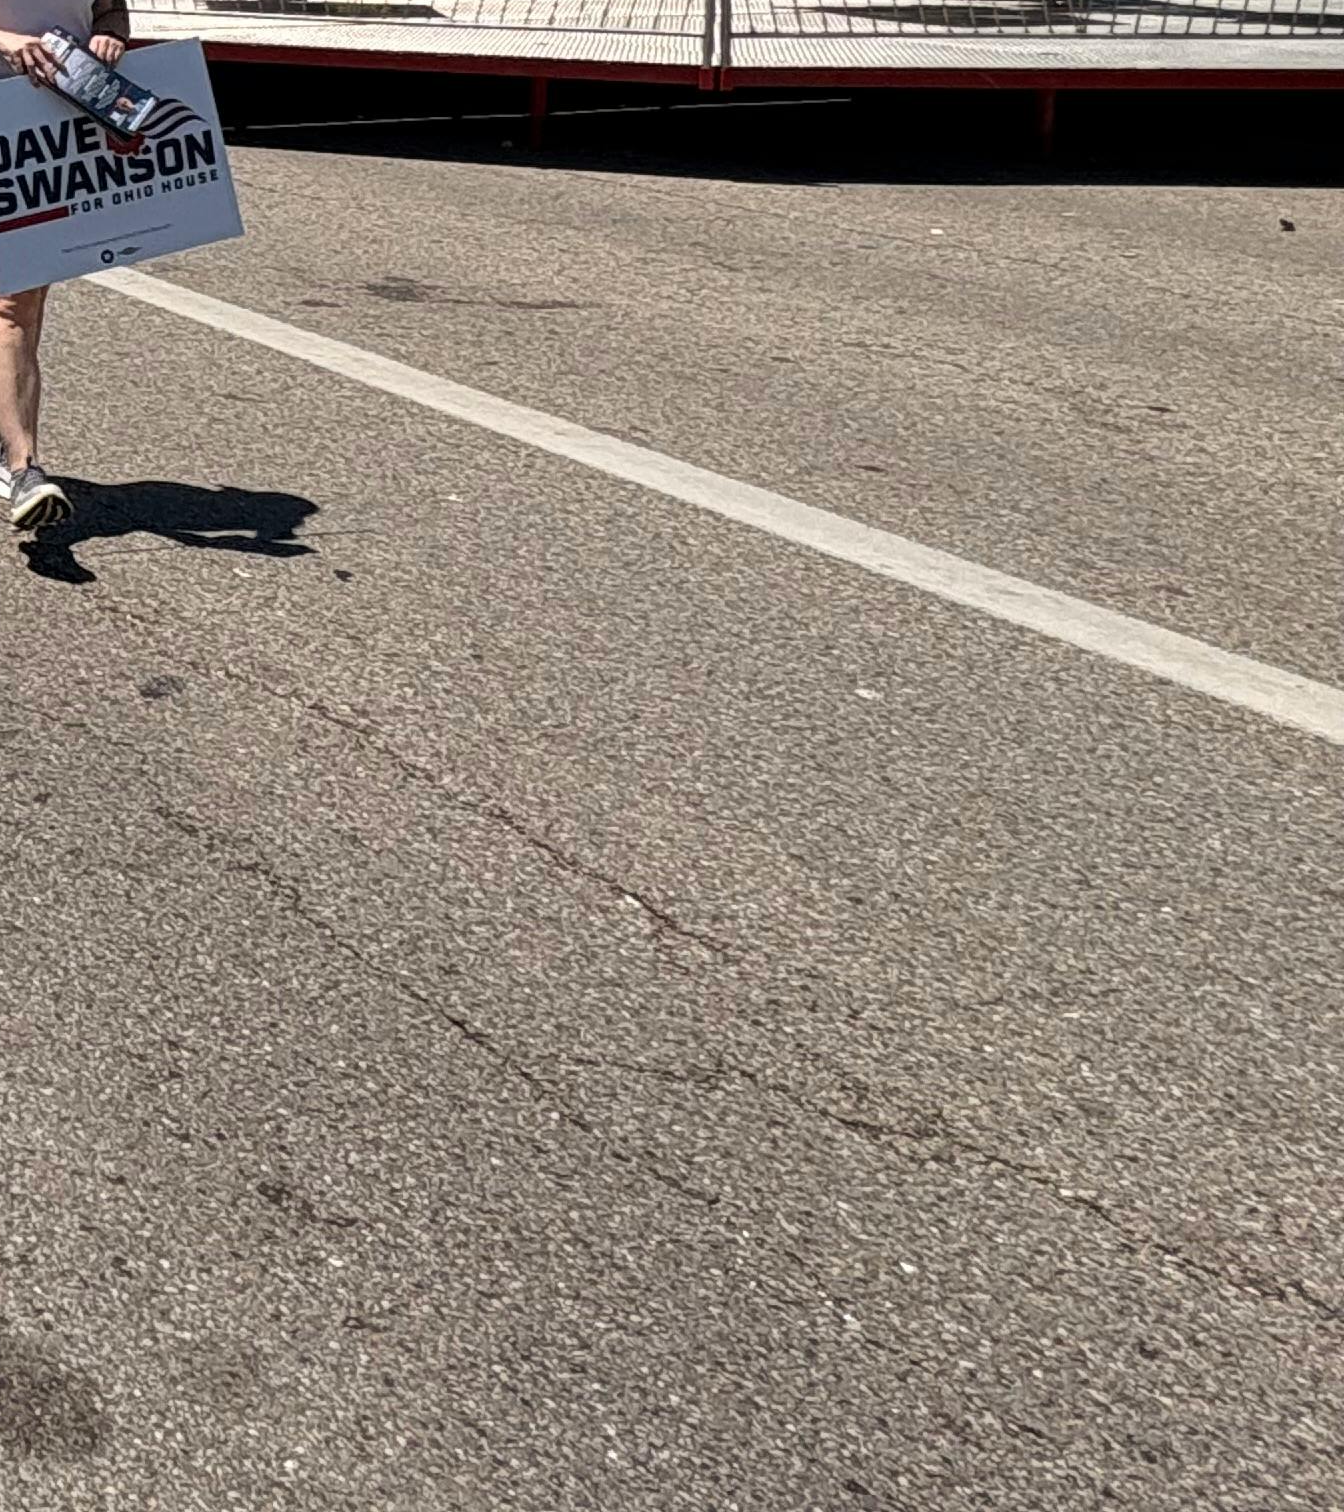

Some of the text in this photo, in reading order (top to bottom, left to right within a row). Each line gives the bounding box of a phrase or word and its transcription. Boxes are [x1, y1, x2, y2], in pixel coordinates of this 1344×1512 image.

[70, 168, 219, 216] FOR OHIO HOUSE
